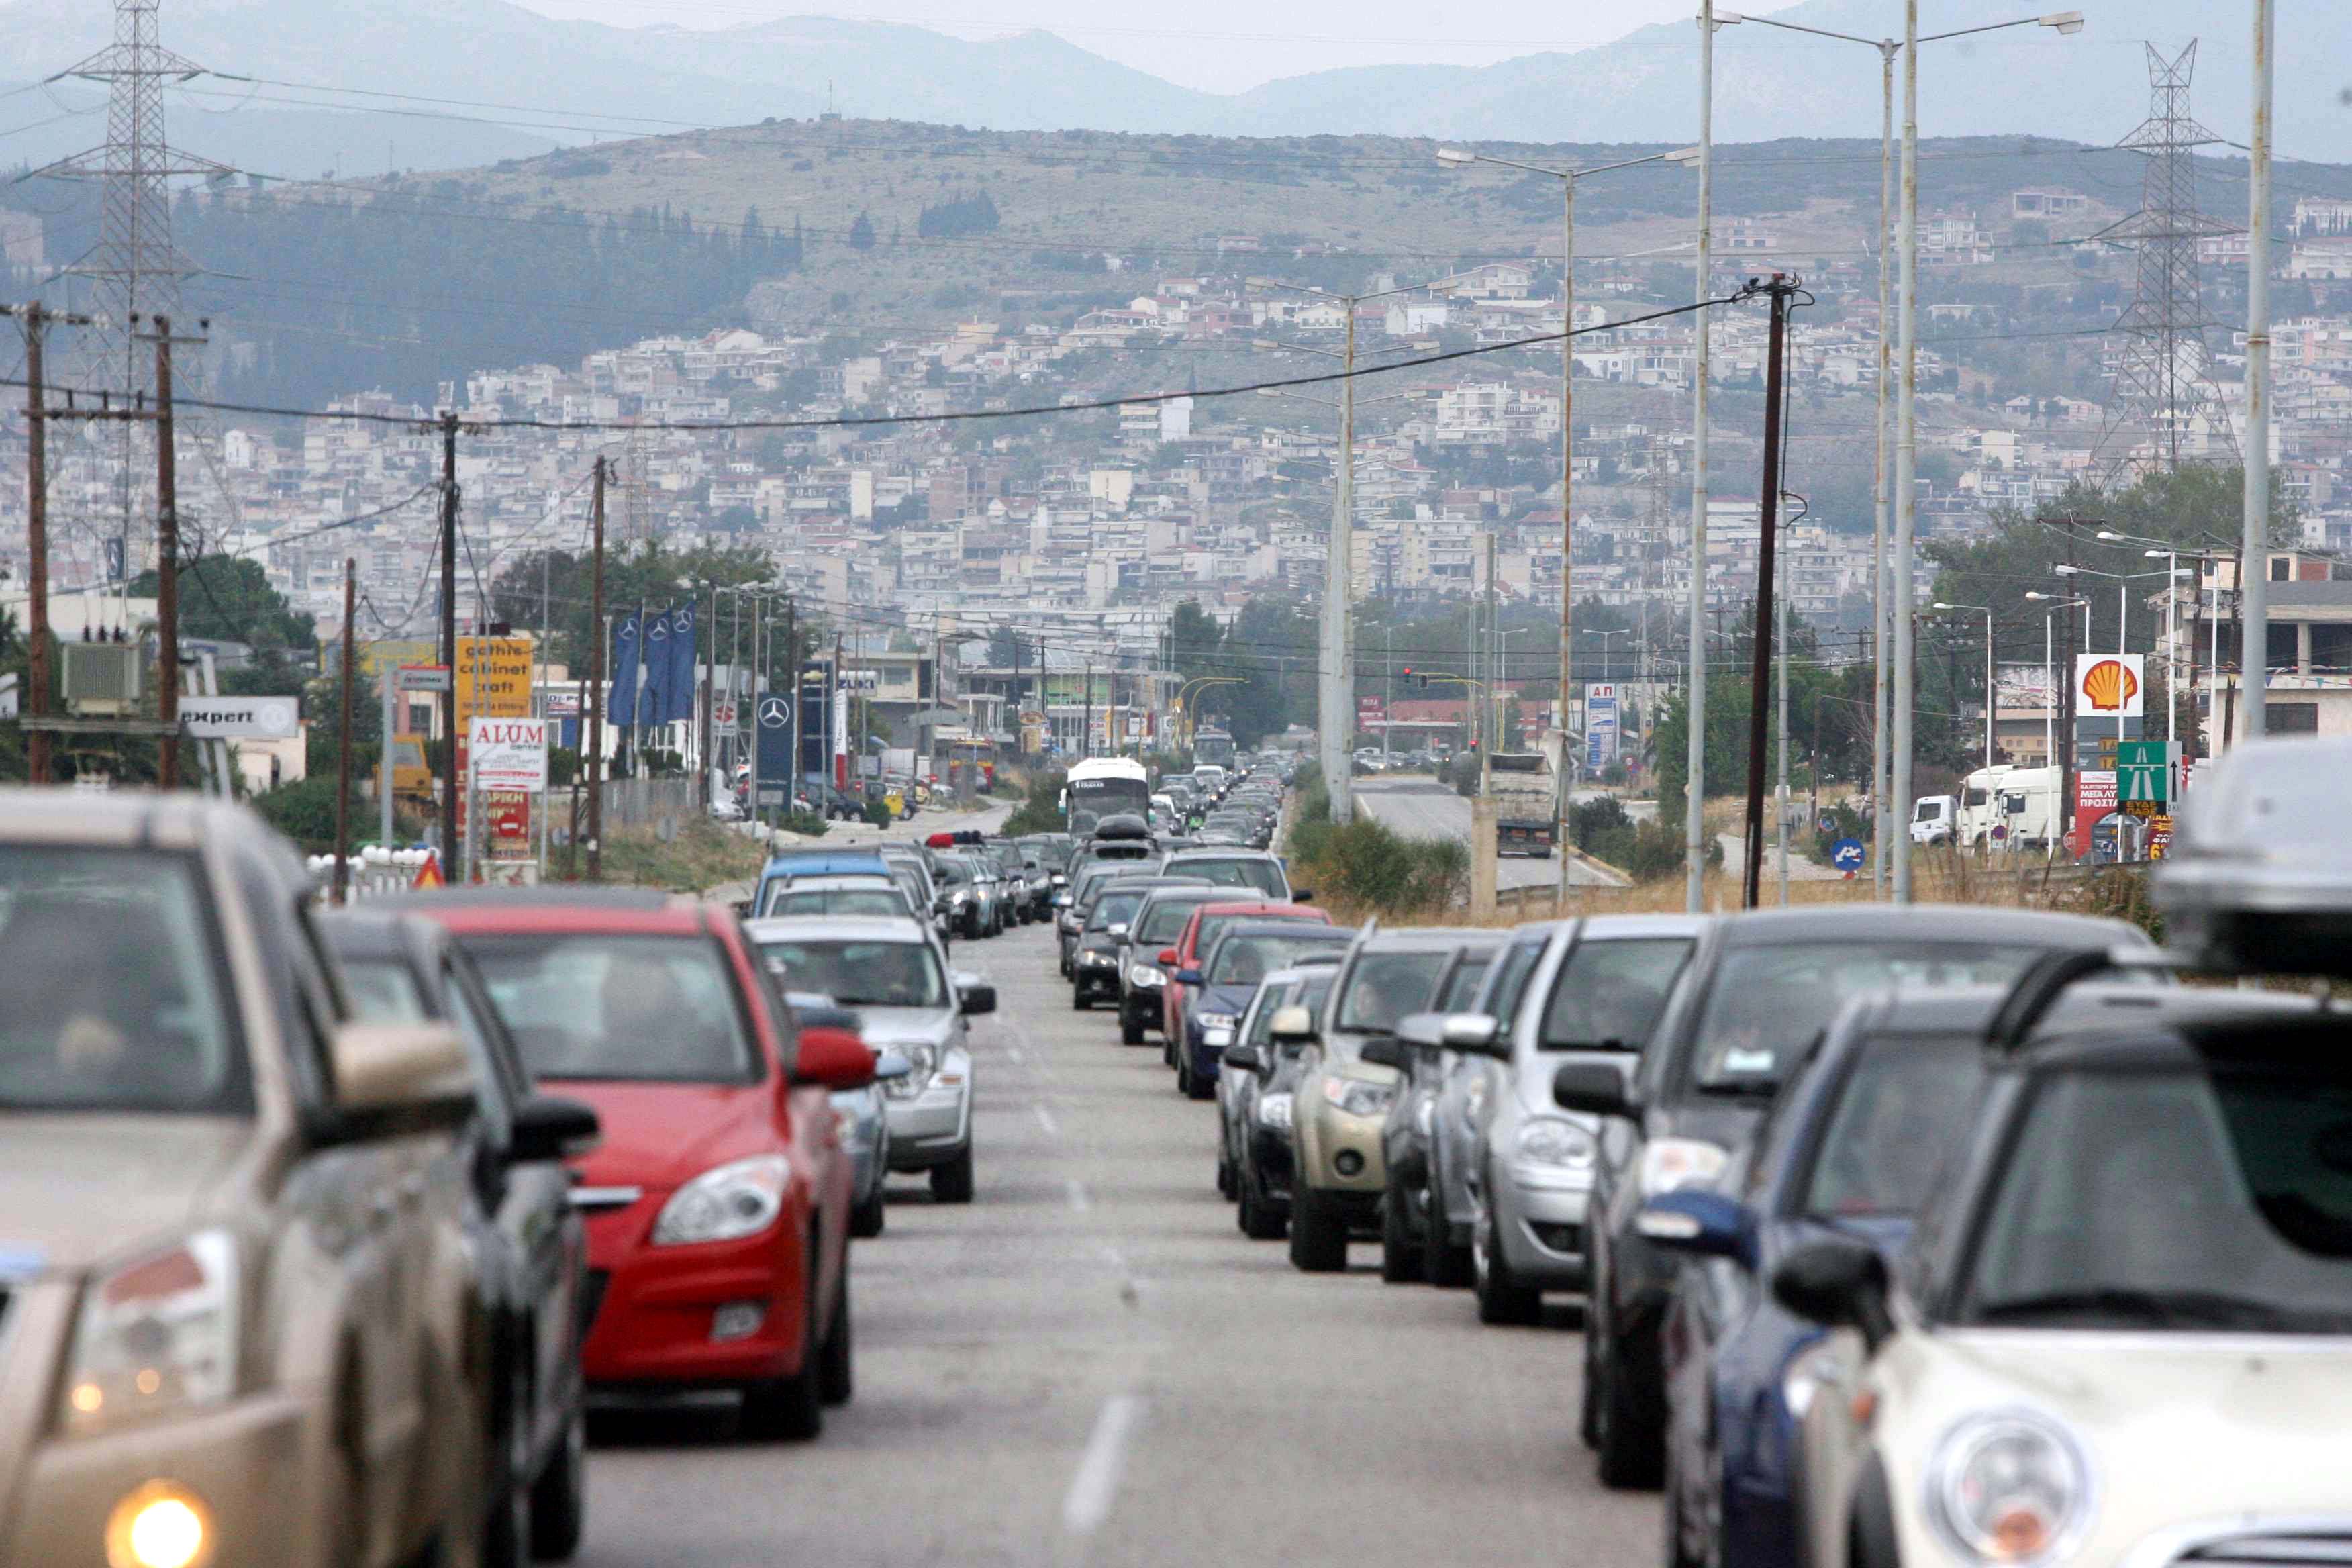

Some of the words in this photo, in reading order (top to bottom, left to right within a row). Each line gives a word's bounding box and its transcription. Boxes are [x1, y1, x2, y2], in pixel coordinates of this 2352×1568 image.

[838, 679, 874, 689] ZUKI
[182, 711, 254, 724] expert
[475, 724, 543, 743] ALUM
